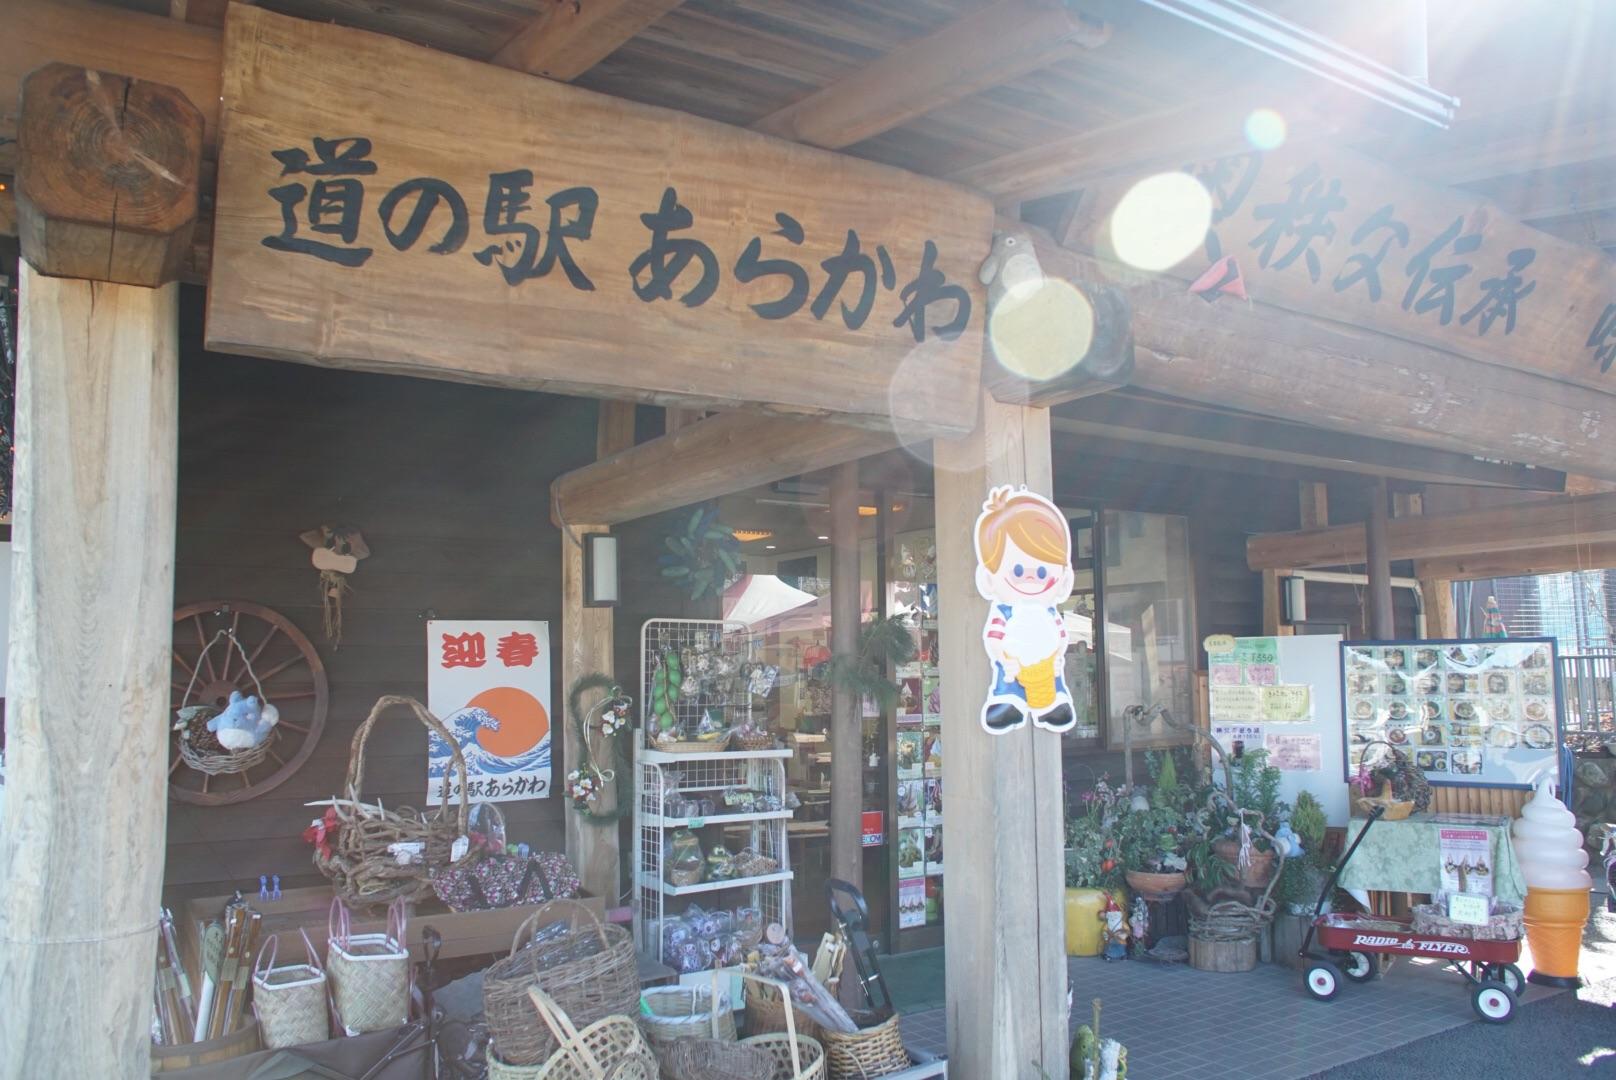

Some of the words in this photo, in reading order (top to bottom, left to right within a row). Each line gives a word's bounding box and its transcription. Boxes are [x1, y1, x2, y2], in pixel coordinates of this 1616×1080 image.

[260, 136, 599, 293] 道の駅
[627, 187, 973, 343] あらかわ
[440, 631, 539, 669] 迎春
[1353, 935, 1399, 946] RADIO
[1417, 941, 1469, 954] FLYER
